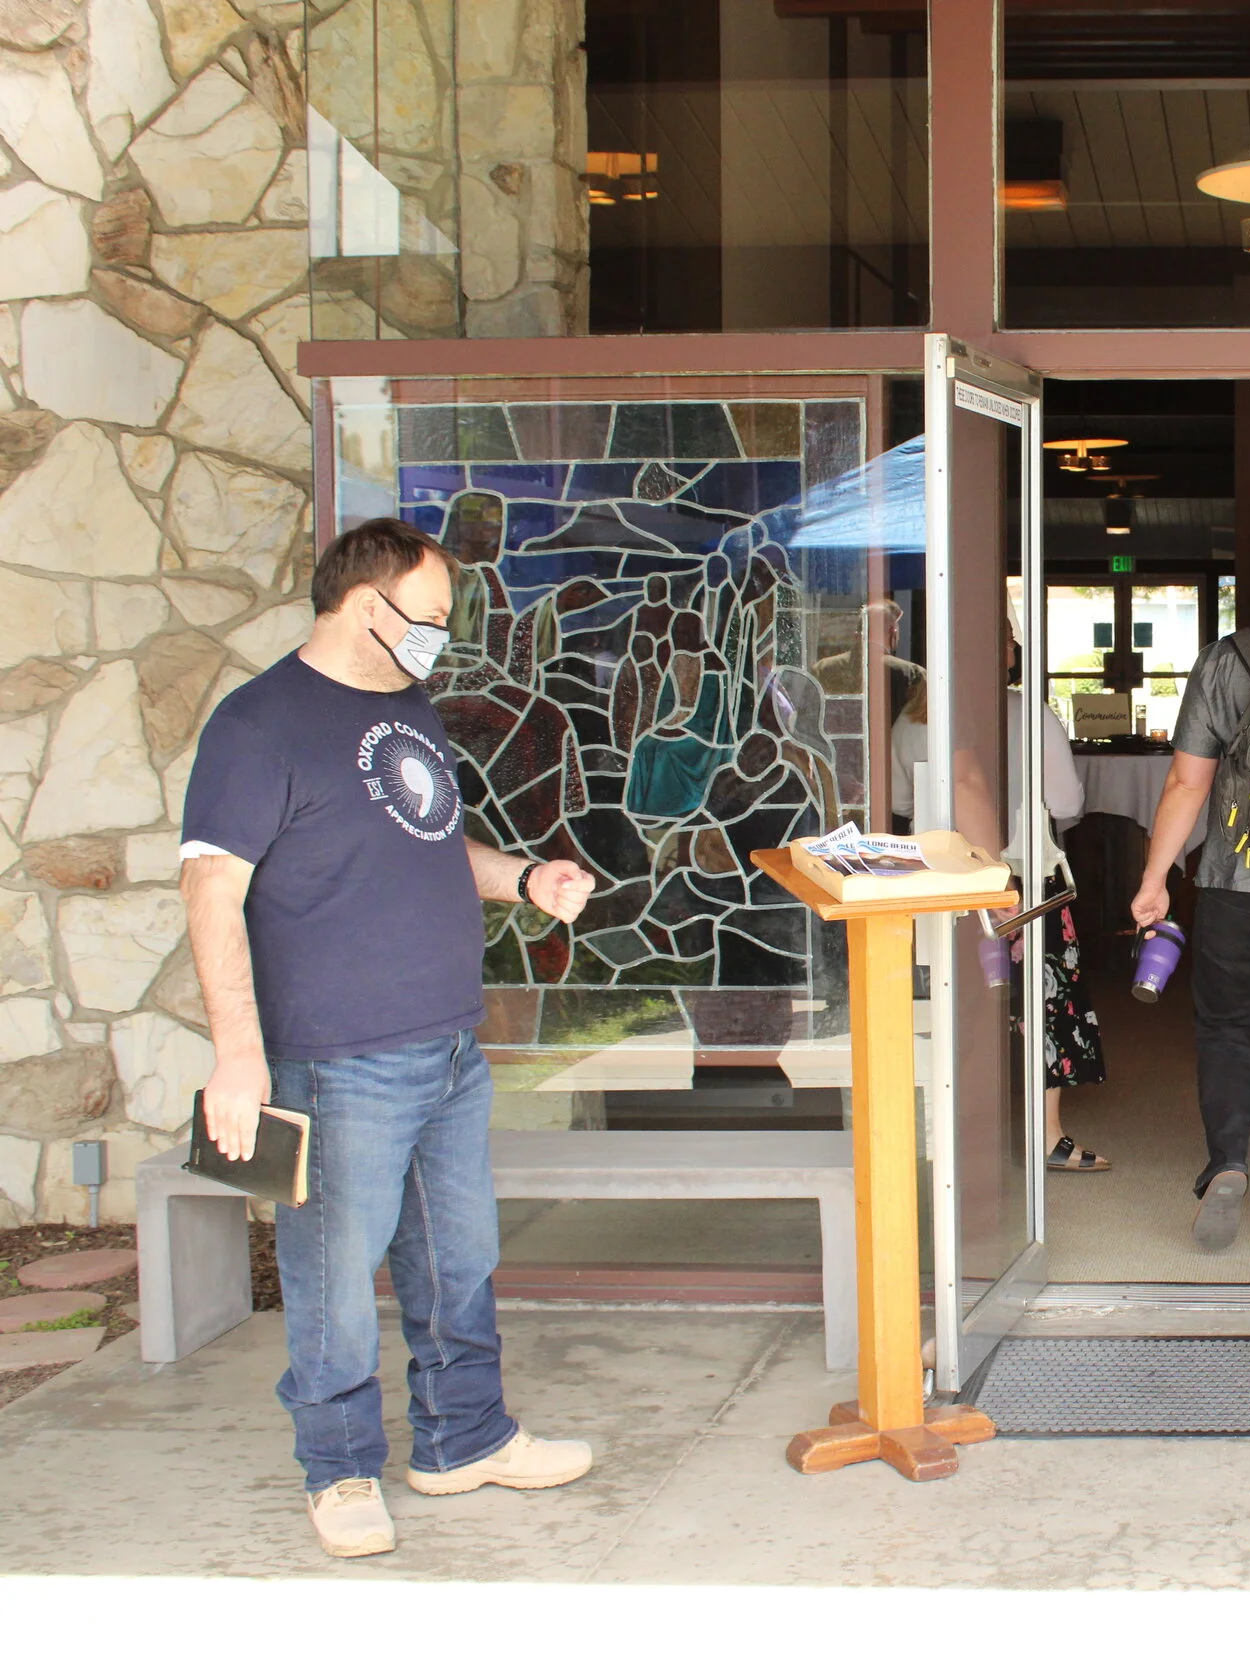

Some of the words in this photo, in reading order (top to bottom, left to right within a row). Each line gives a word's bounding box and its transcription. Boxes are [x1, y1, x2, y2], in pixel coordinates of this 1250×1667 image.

[1113, 555, 1133, 572] EXIT
[1075, 707, 1128, 722] Communion
[357, 721, 393, 771] OXFORD
[394, 721, 445, 763] COMMA
[385, 804, 447, 841] APPRECIATION
[445, 796, 463, 835] SOCIETY
[867, 840, 889, 848] LONG
